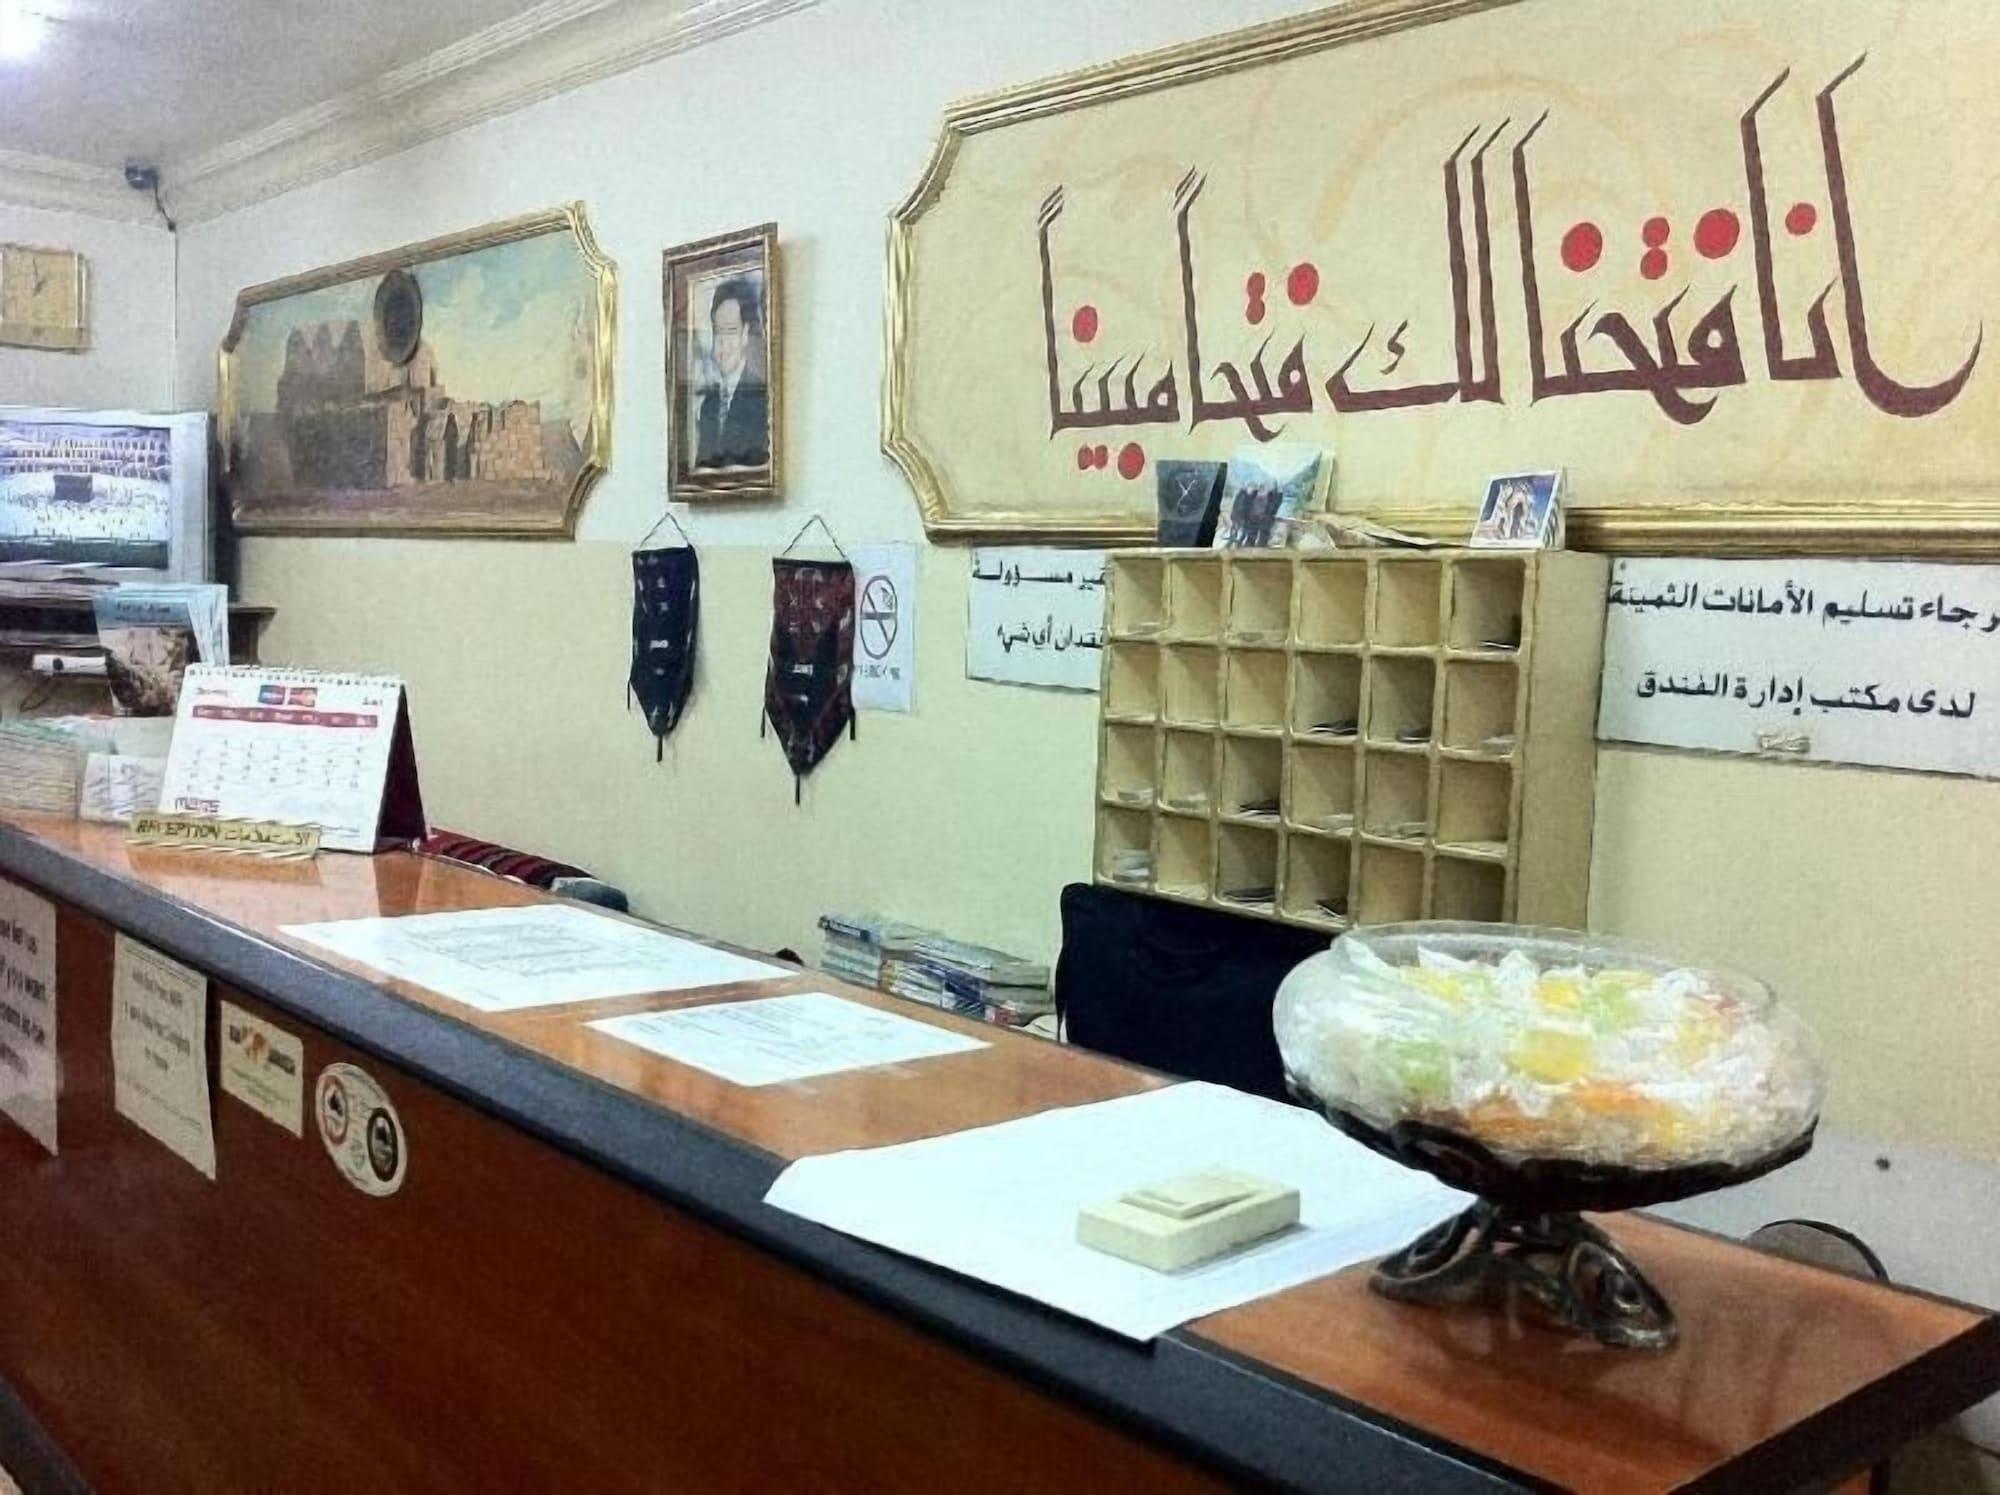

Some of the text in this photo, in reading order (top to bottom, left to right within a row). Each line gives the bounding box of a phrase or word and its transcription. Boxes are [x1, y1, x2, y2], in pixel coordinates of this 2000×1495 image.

[1325, 117, 1507, 412] لك
[1512, 108, 1746, 425] فتحنا
[1607, 581, 1698, 613] الثمينة
[1702, 579, 1814, 614] الأمانات
[1822, 589, 1914, 630] تسليم
[1636, 670, 1976, 719] لدى مكتب إدارة الفندق
